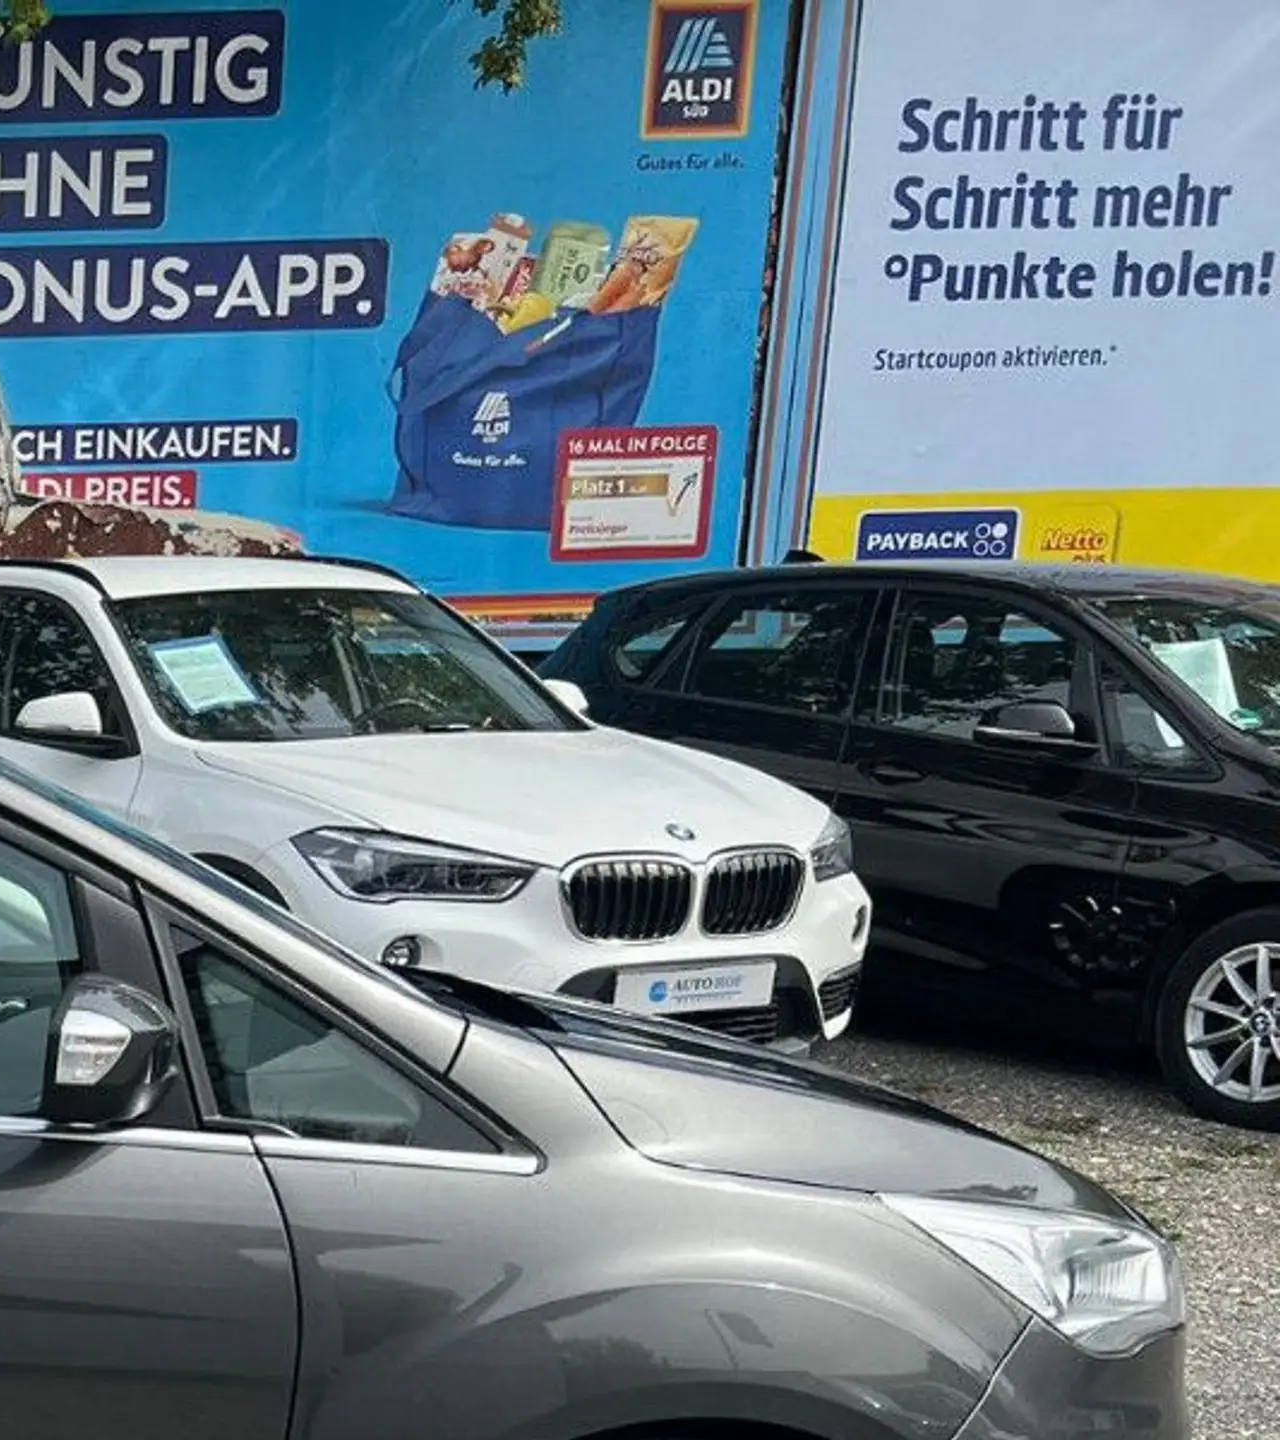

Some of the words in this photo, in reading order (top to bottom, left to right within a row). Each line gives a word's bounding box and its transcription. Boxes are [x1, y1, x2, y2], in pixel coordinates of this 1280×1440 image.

[661, 77, 733, 102] ALDI
[897, 95, 1087, 152] Schritt
[1102, 94, 1183, 150] für
[636, 155, 681, 170] Gutes
[685, 153, 709, 168] für
[713, 151, 744, 168] alle.
[890, 172, 1079, 230] Schritt
[1092, 173, 1233, 228] mehr
[1111, 250, 1275, 298] holen!
[873, 349, 996, 371] Startcoupon
[471, 420, 509, 435] ALDI
[12, 430, 62, 461] CH
[74, 424, 291, 460] EINKAUFEN.
[568, 439, 584, 454] 16
[587, 437, 625, 453] MAL
[627, 437, 647, 452] IN
[651, 434, 708, 451] FOLGE
[85, 475, 193, 509] PREIS.
[571, 479, 615, 495] Platz
[867, 531, 969, 551] PAYBACK
[1042, 529, 1106, 550] Netto
